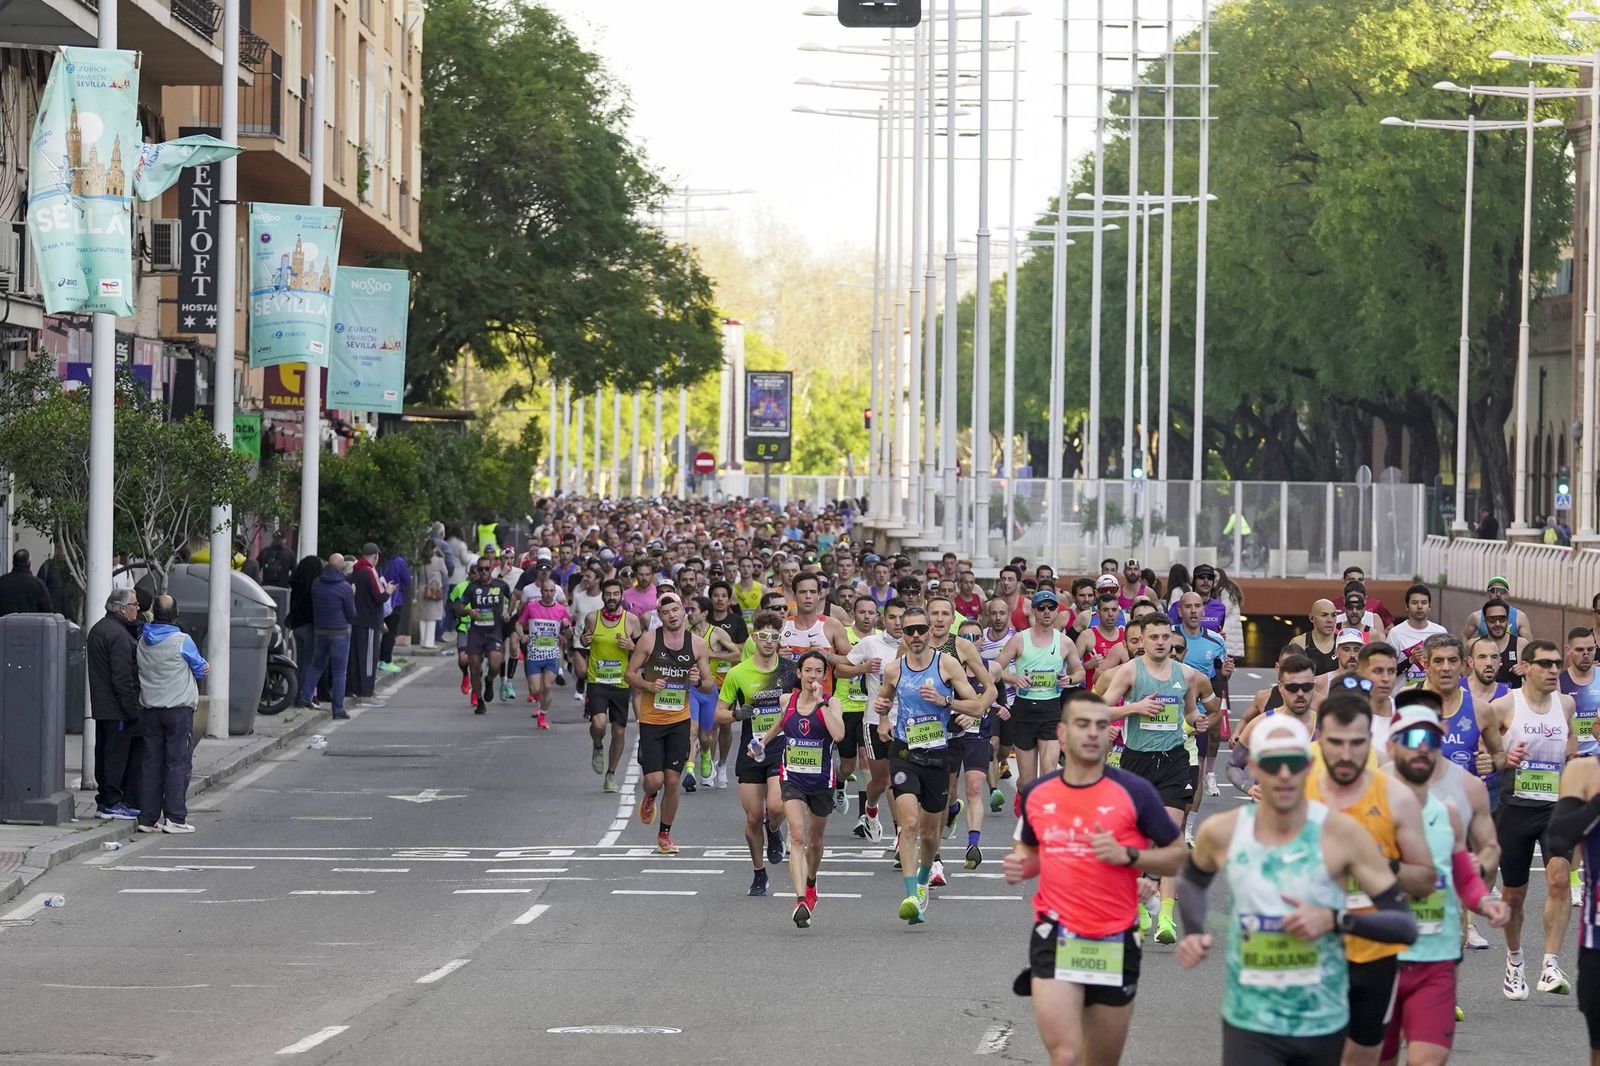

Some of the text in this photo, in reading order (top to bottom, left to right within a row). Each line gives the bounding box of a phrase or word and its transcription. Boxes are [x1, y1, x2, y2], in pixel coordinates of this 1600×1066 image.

[76, 80, 106, 88] SEVILLA
[190, 165, 213, 297] ENTOFT
[254, 296, 329, 318] SEVILLA
[348, 325, 377, 333] ZURICH
[346, 341, 377, 349] SEVILLA
[659, 696, 682, 704] MARTIN
[916, 715, 938, 723] ZURICH
[929, 730, 944, 739] RUIZ
[790, 756, 818, 766] GICQUEL
[1521, 781, 1553, 791] OLIVIER
[1071, 957, 1107, 970] HODEI
